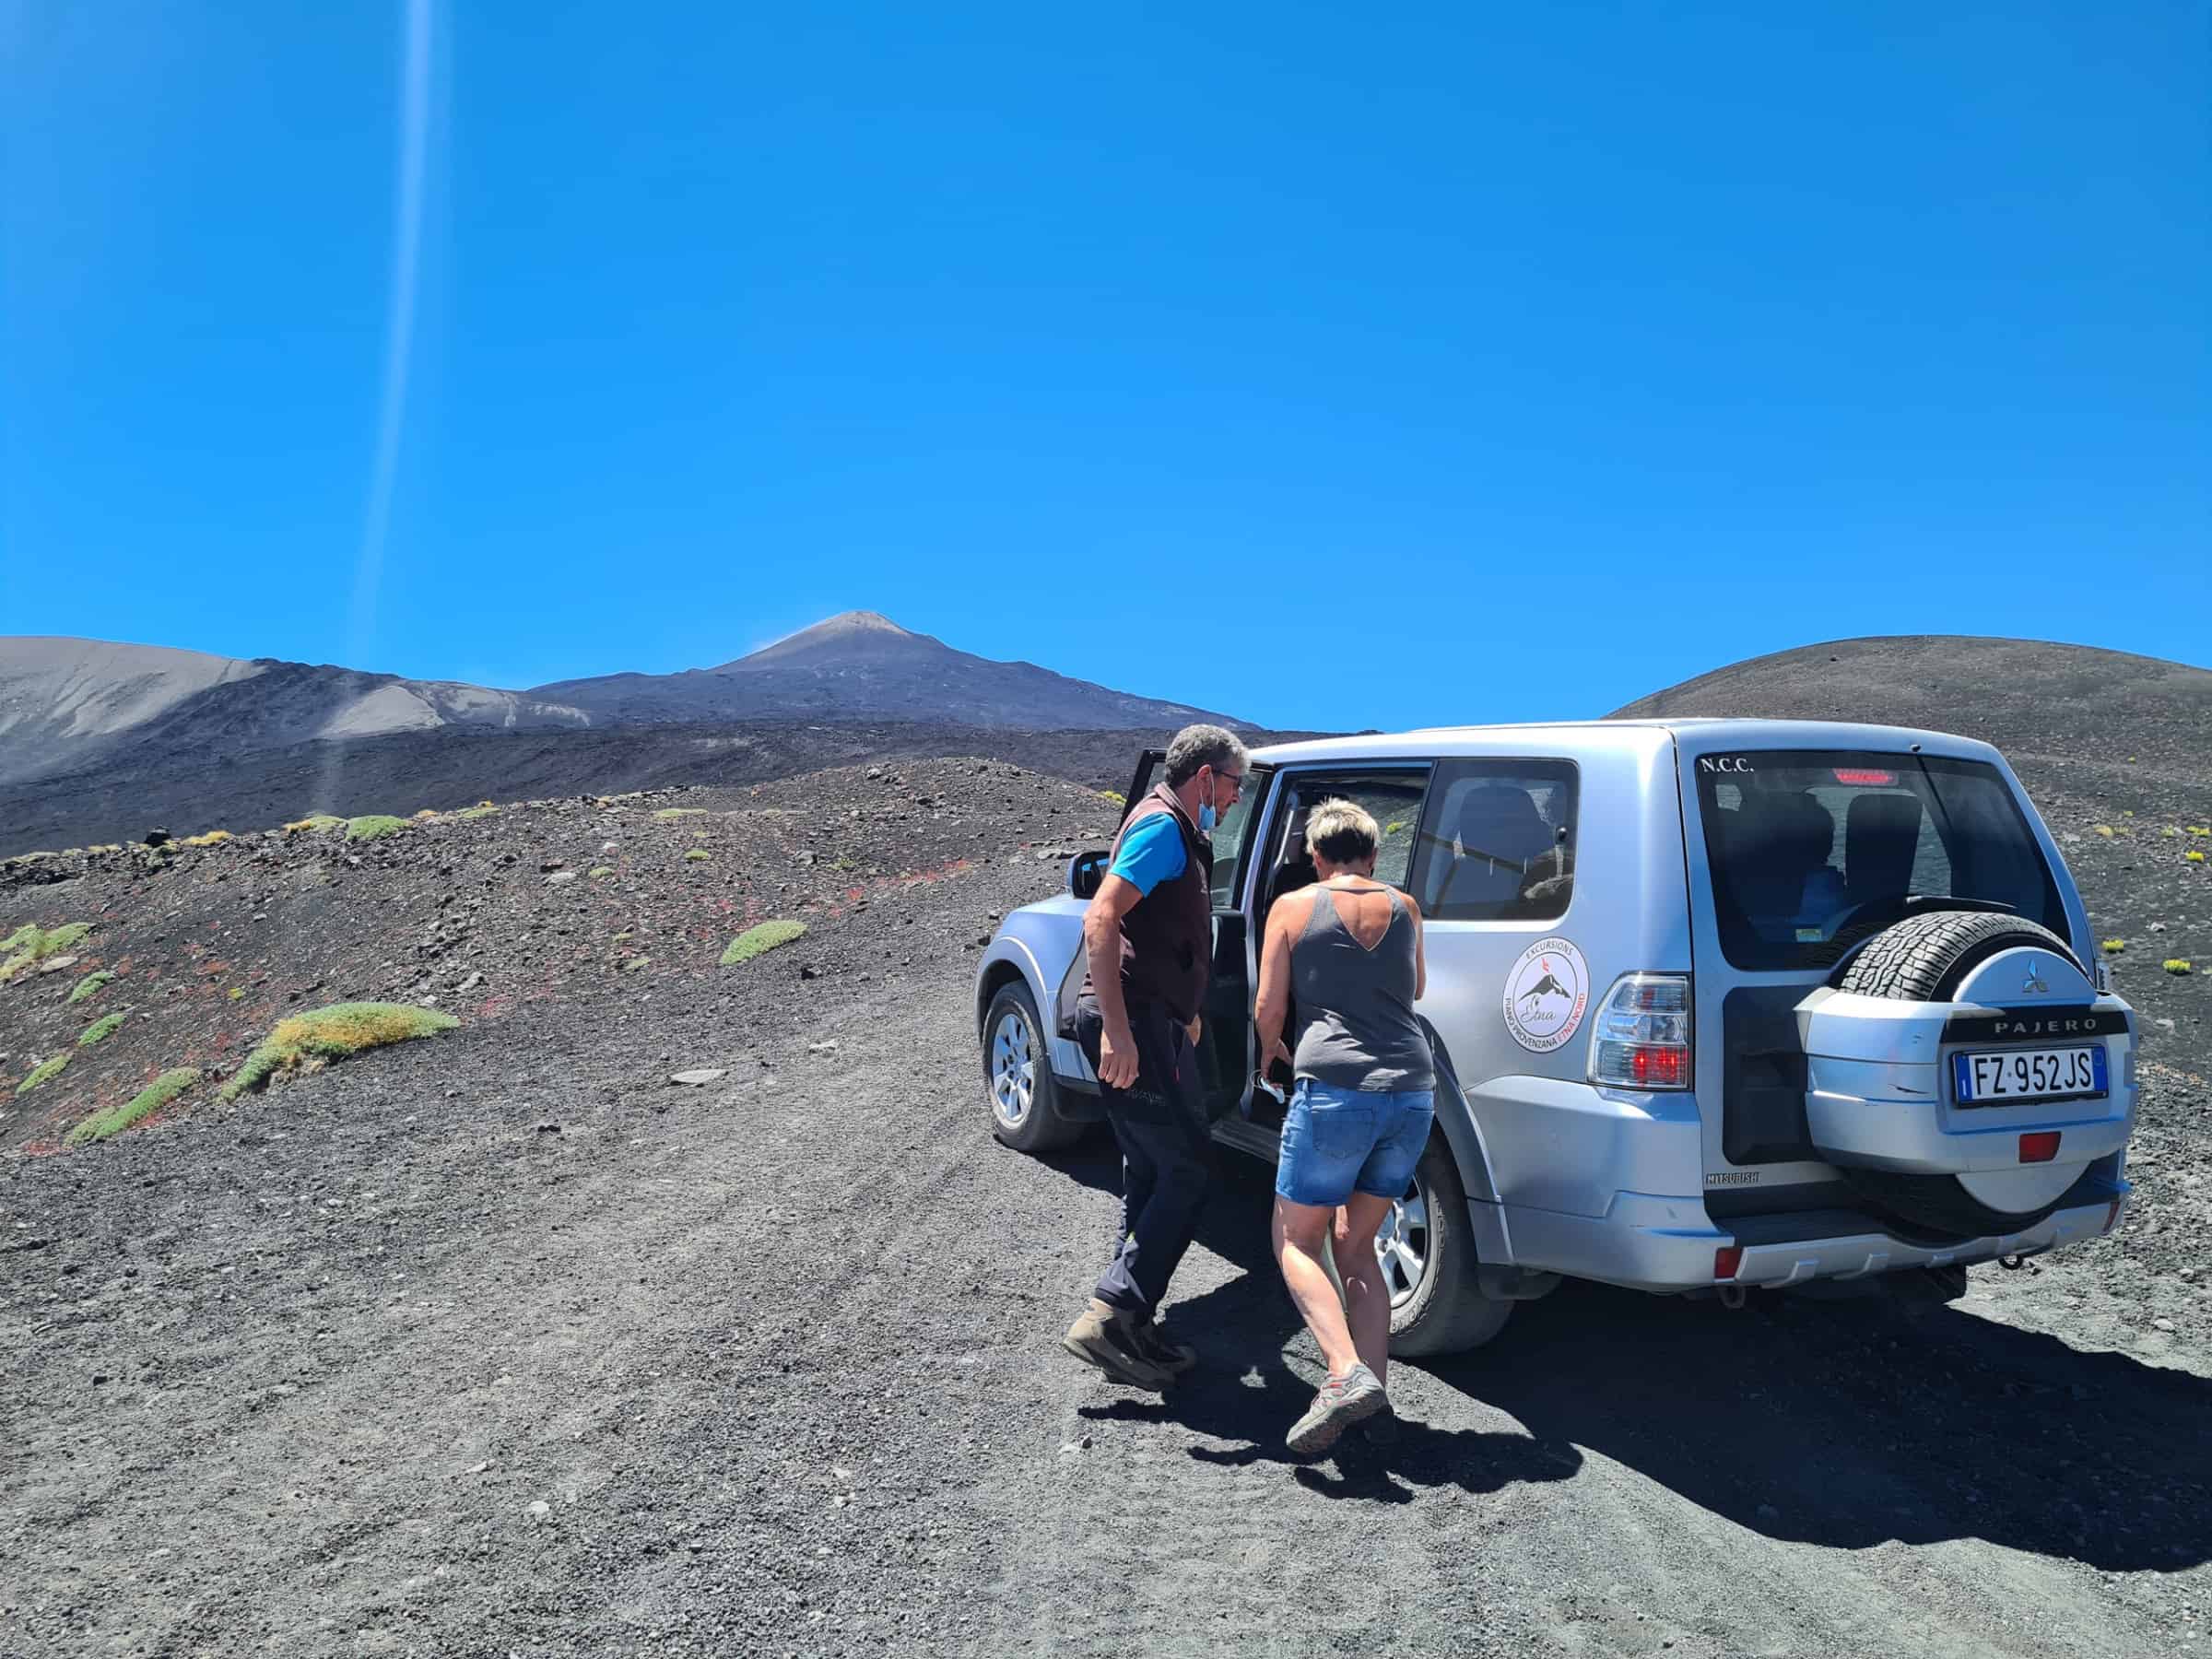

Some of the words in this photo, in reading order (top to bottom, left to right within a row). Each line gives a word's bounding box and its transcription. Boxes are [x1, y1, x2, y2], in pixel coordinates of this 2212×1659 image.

[1700, 758, 1755, 772] N.C.C.
[1526, 940, 1573, 959] EXCURSIONS
[1512, 1026, 1558, 1049] PROVENZANA
[1558, 1022, 1575, 1041] ETNA
[1571, 993, 1586, 1021] NORD
[1994, 1018, 2096, 1033] PAJERO
